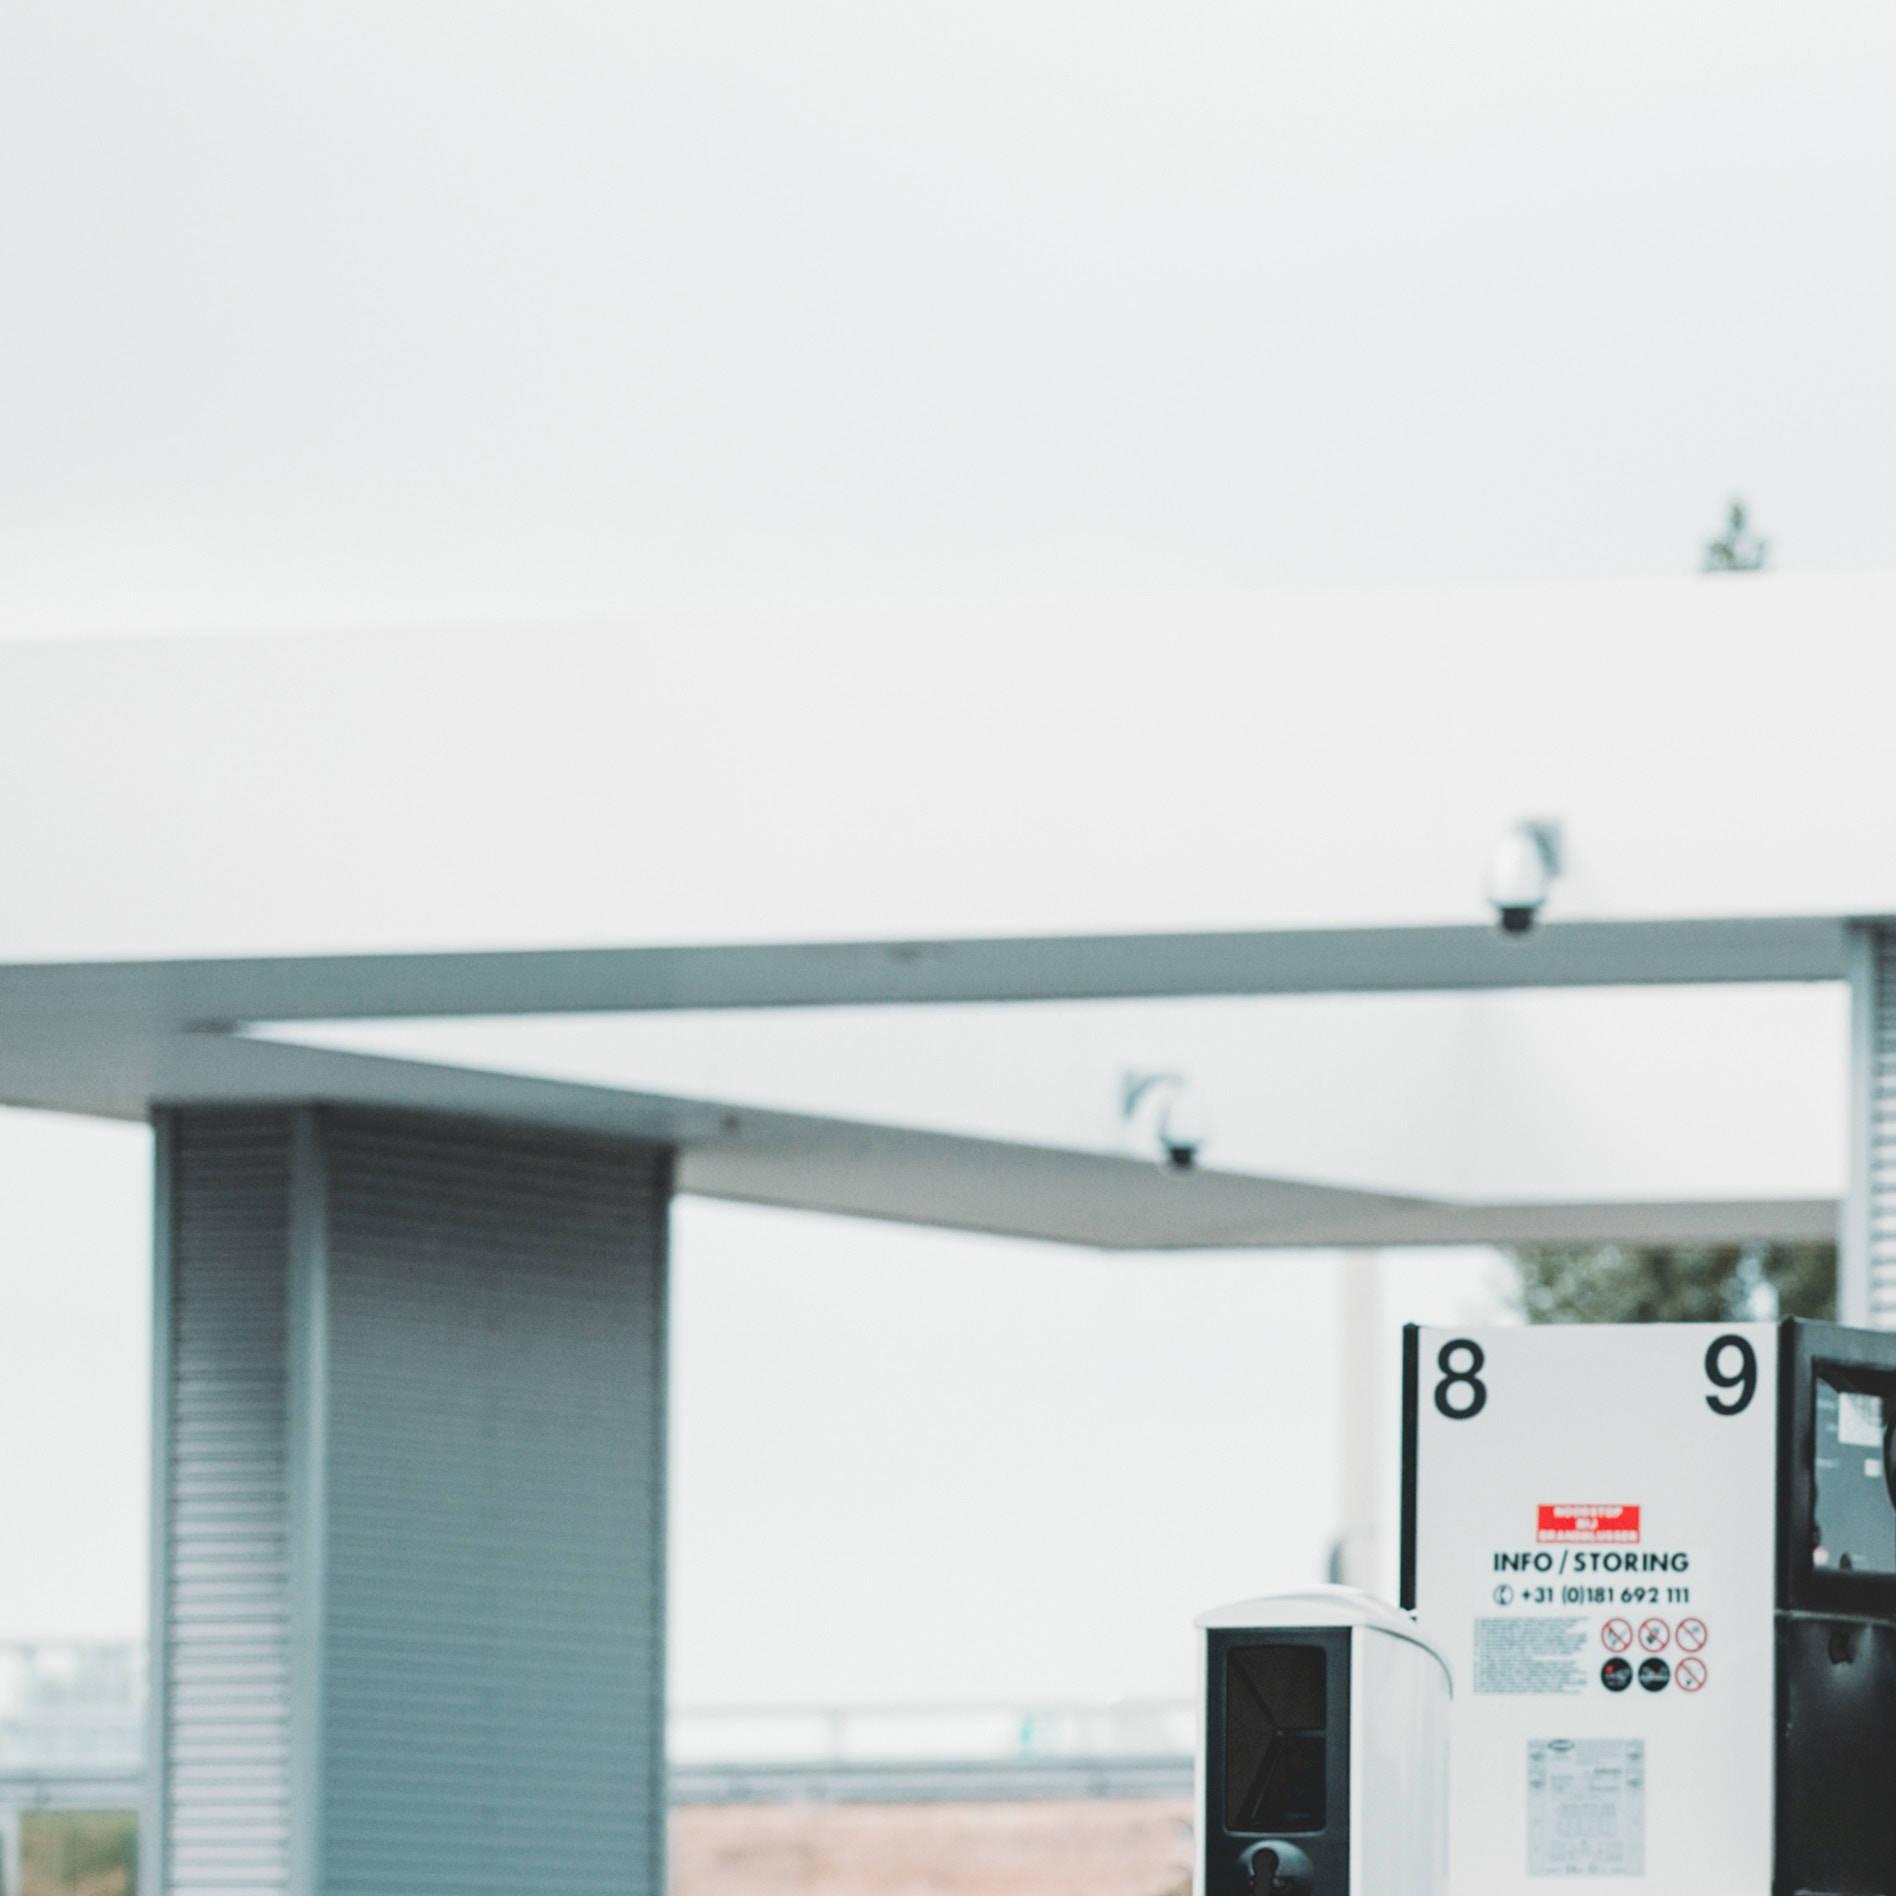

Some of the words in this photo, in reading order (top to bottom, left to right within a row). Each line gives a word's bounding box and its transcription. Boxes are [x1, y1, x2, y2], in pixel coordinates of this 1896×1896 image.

[1434, 1338, 1487, 1420] 8
[1704, 1334, 1757, 1416] 9
[1494, 1552, 1552, 1572] INFO
[1574, 1552, 1689, 1572] STORING
[1522, 1587, 1553, 1604] +31
[1562, 1585, 1614, 1605] (0)181
[1620, 1587, 1658, 1604] 692
[1667, 1587, 1689, 1604] 111
